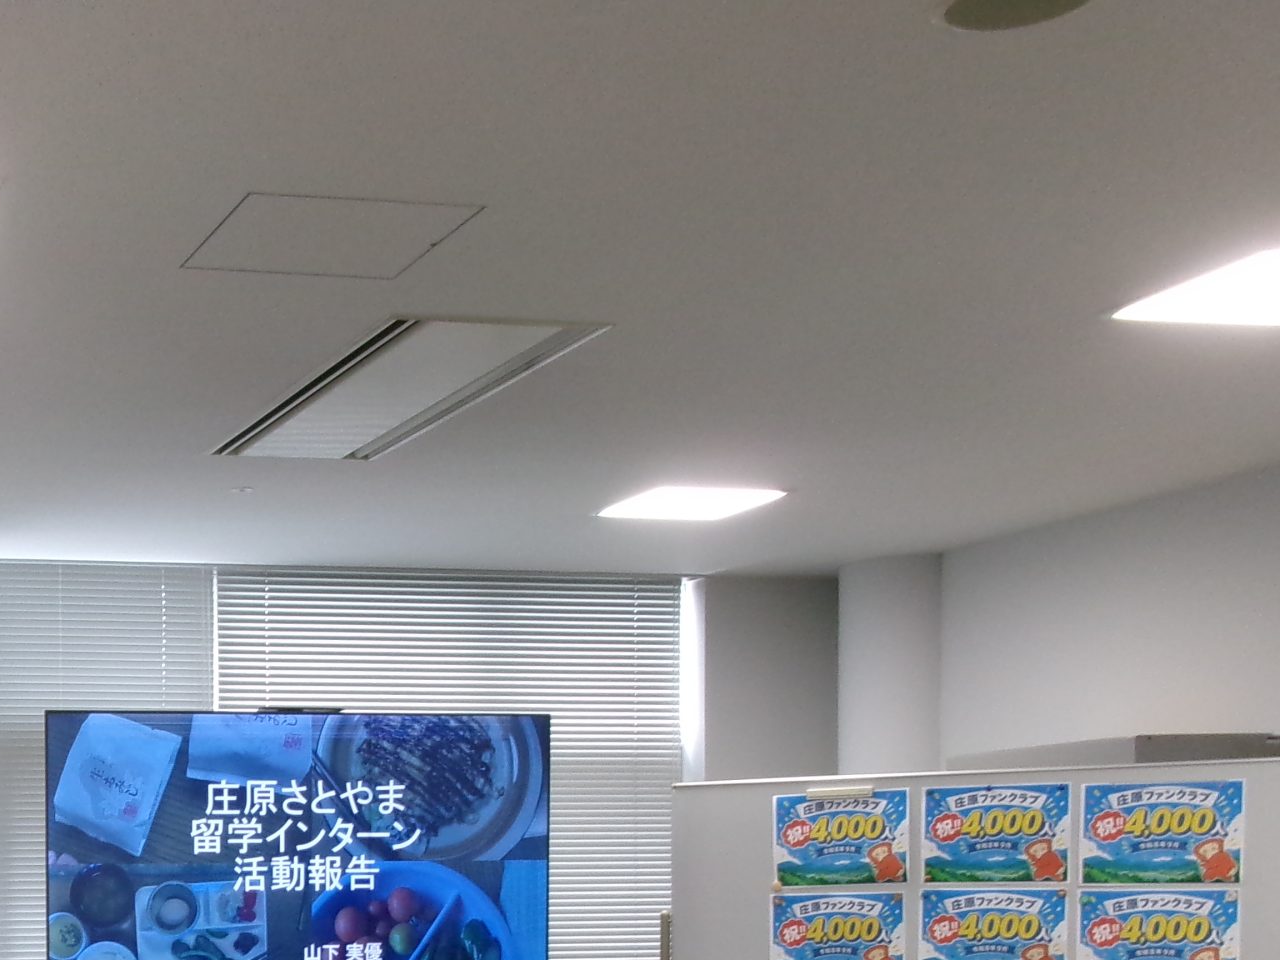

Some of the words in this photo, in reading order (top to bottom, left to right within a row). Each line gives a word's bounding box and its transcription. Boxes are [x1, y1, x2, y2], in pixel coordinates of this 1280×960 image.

[205, 779, 406, 817] 庄原さとやま
[954, 793, 1040, 809] 庄原ファンクラブ
[1116, 790, 1212, 806] 庄原ファンクラブ
[803, 799, 881, 815] 庄原ファンクラブ
[190, 817, 421, 855] 留学インターン
[233, 855, 380, 891] 活動報告
[800, 901, 878, 915] 庄原ファンクラブ
[951, 897, 1037, 911] 庄原ファンクラブ
[1113, 898, 1207, 913] 庄原ファンクラブ
